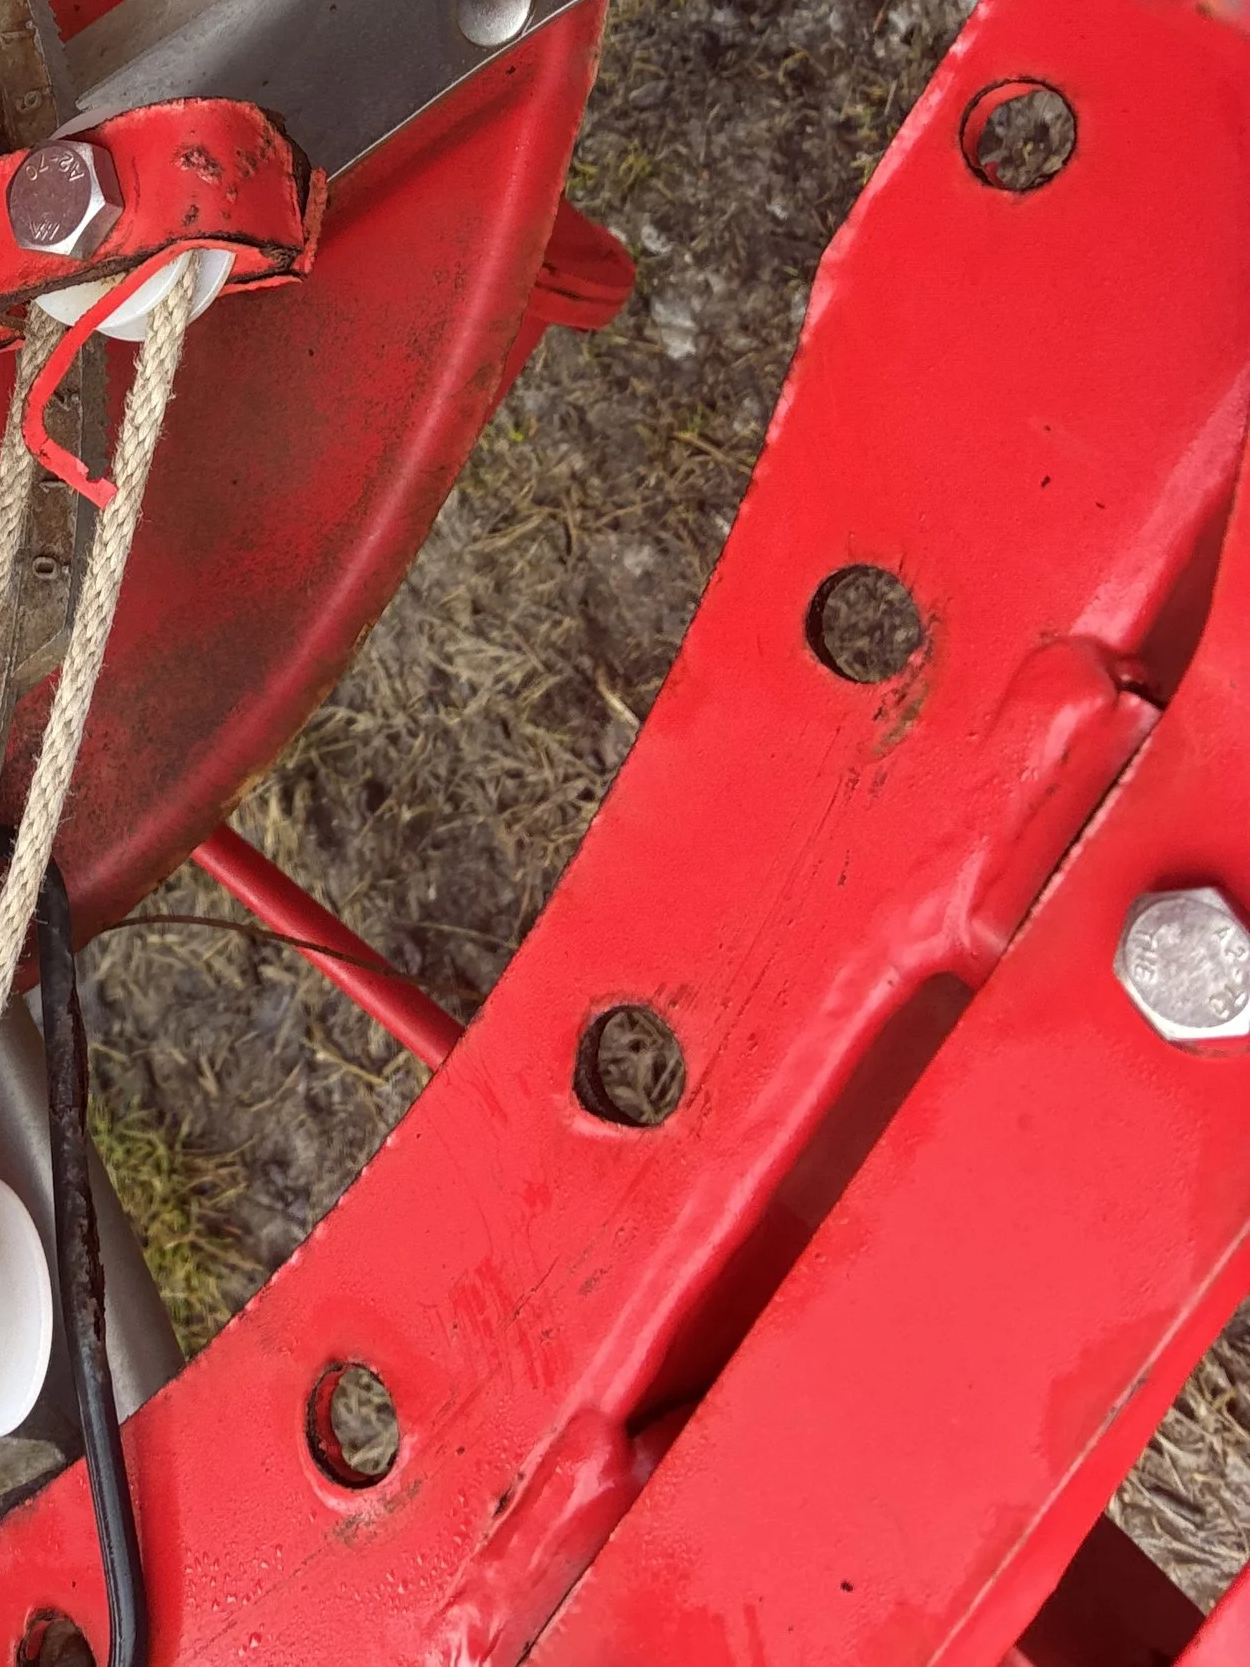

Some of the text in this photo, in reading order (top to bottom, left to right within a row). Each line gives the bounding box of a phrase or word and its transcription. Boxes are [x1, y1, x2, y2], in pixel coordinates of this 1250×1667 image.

[15, 90, 43, 114] 6
[25, 151, 86, 182] A2-70
[32, 557, 59, 579] 0
